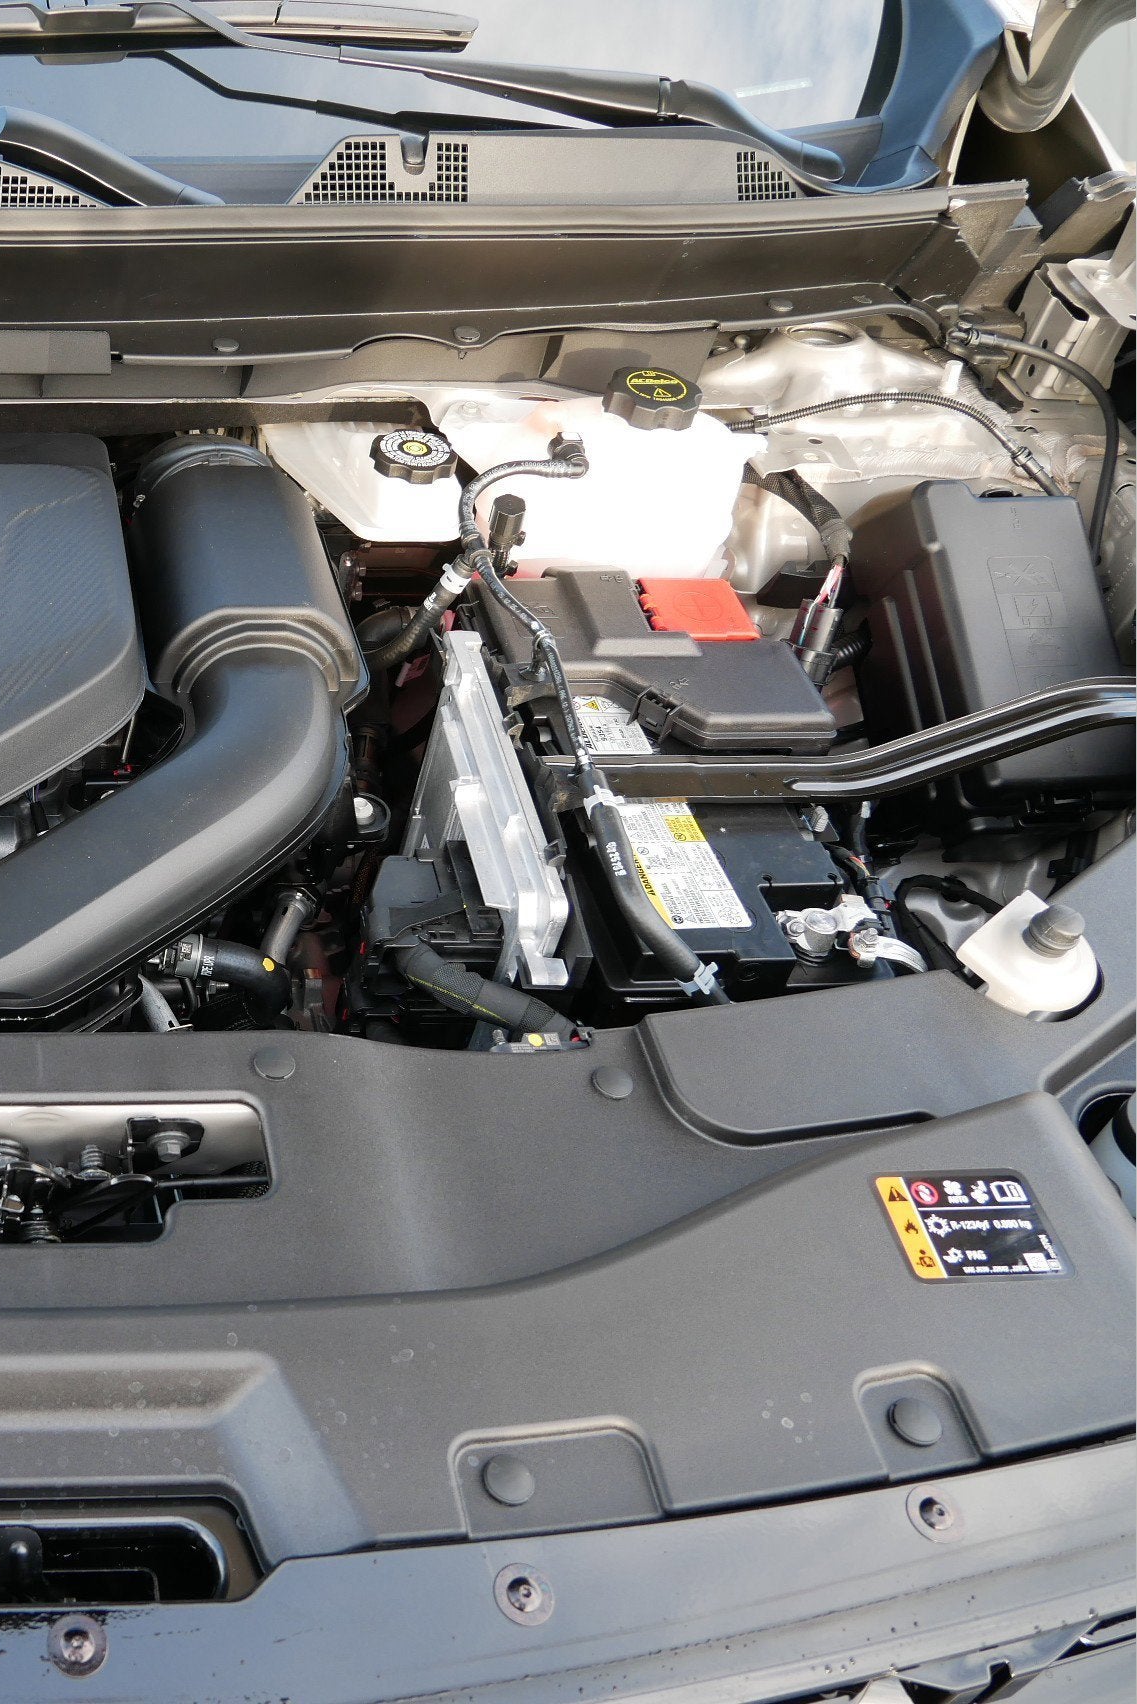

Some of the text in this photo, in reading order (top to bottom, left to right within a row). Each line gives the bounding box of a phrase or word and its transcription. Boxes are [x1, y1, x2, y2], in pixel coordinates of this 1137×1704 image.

[950, 1219, 990, 1231] R-1234yf
[1018, 1218, 1033, 1230] kg
[965, 1250, 988, 1261] PAG
